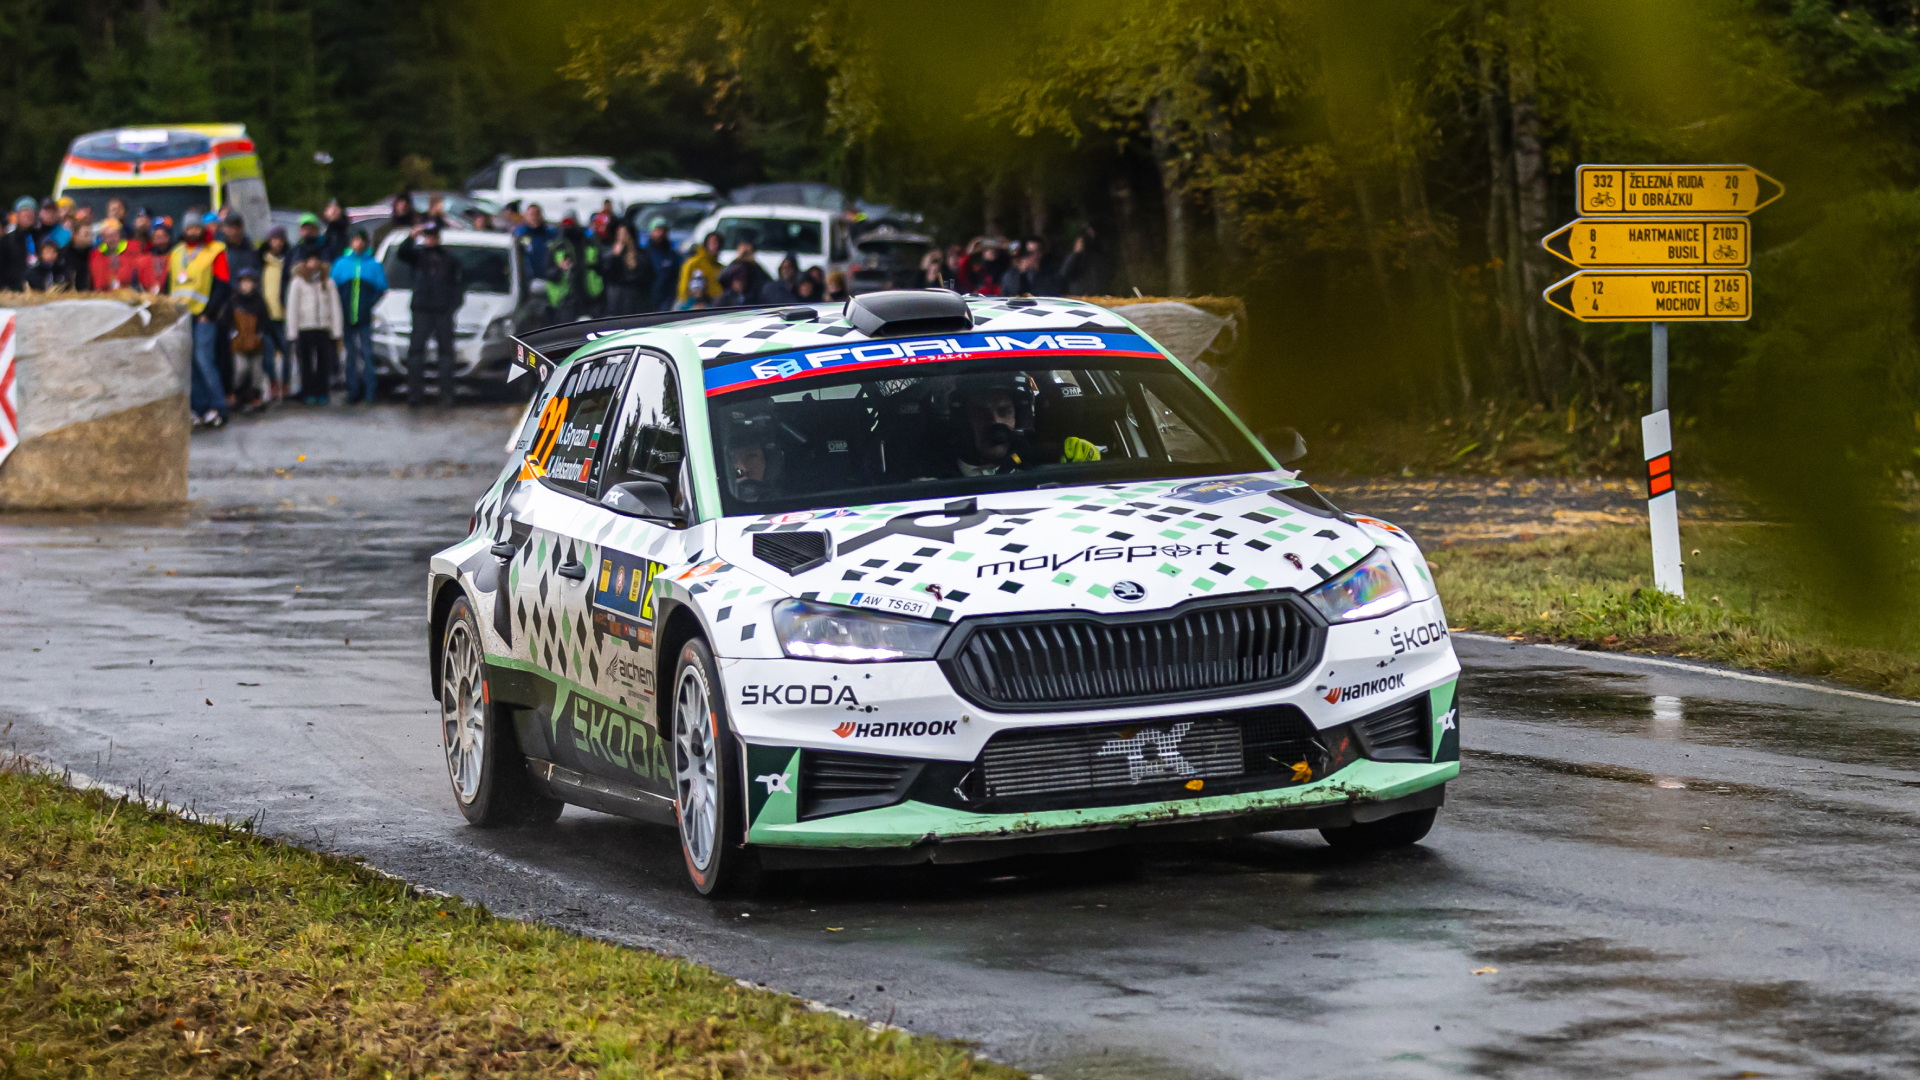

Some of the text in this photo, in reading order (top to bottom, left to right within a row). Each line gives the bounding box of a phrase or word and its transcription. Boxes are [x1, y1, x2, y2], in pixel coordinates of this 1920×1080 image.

[1593, 175, 1613, 188] 332
[1629, 172, 1739, 189] ŽELEZNÁ RUDA 20
[1629, 191, 1739, 206] U OBRÁZKU 7
[1590, 228, 1700, 242] 8 HARTMANICE
[1713, 227, 1738, 241] 2103
[1590, 246, 1700, 259] 2 BUSIL
[1592, 281, 1701, 295] 12 VOJETICE
[1714, 279, 1739, 292] 2165
[1592, 298, 1701, 311] 4 MOCHOV
[805, 335, 1107, 368] FORUM8
[862, 595, 883, 606] AW
